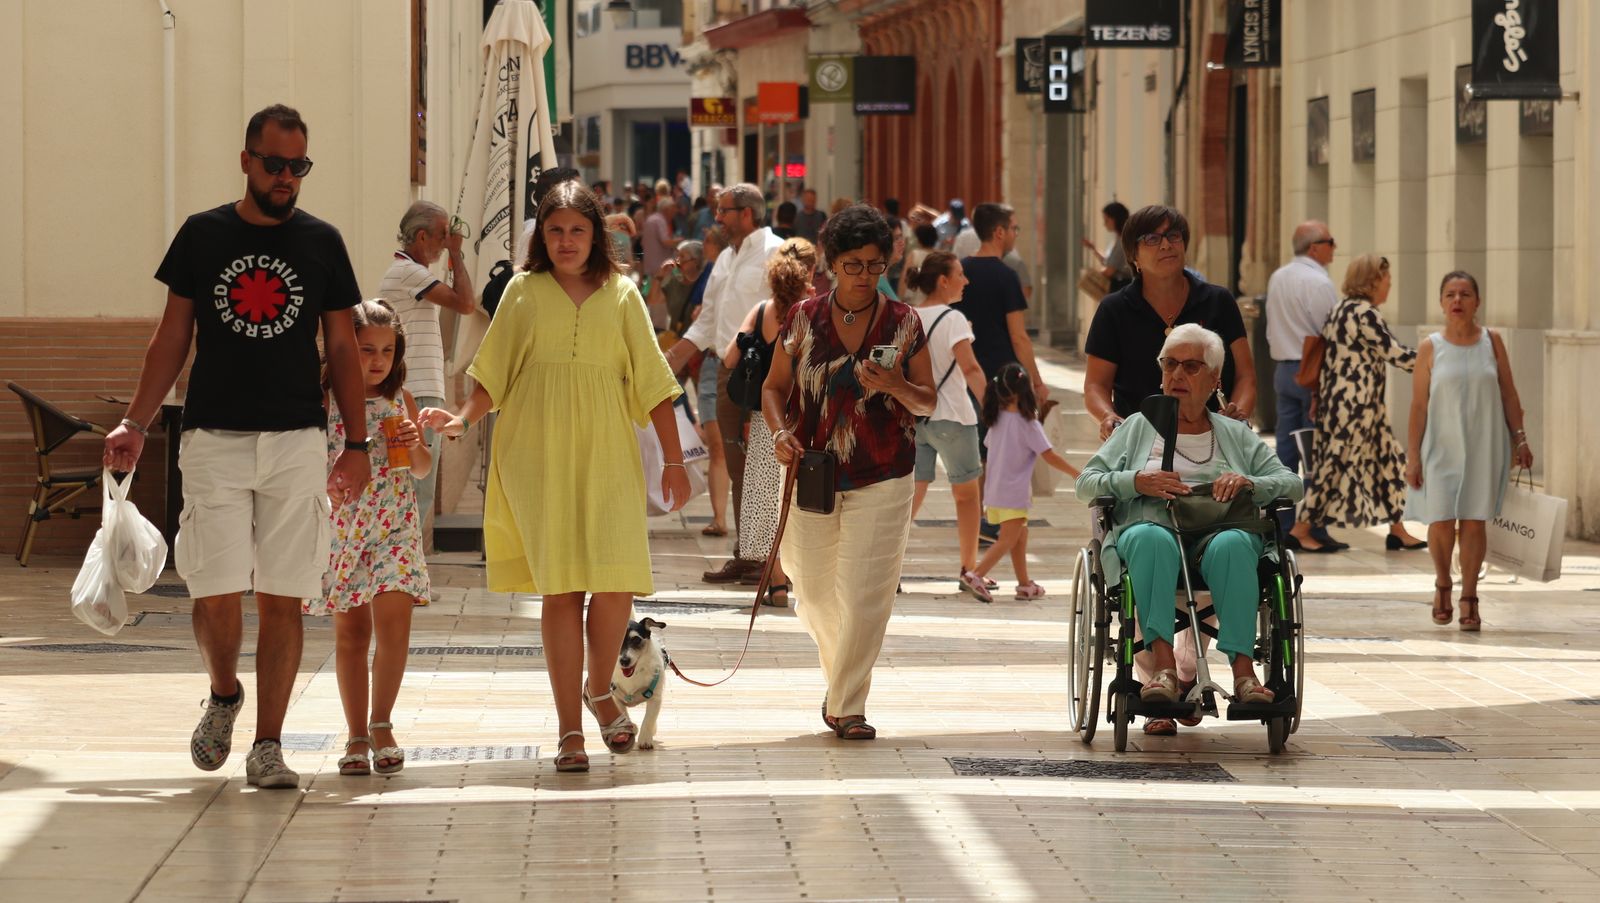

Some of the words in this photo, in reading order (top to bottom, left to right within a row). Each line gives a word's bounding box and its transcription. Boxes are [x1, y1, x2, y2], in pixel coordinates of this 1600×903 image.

[1090, 25, 1171, 41] TEZENIS
[1244, 11, 1260, 62] LYNCIS
[626, 44, 687, 69] BBV
[219, 254, 256, 284] HOT
[257, 254, 304, 292] CHILI
[214, 283, 234, 324] RED
[232, 294, 304, 339] PEPPERS
[1492, 517, 1536, 540] MANGO
